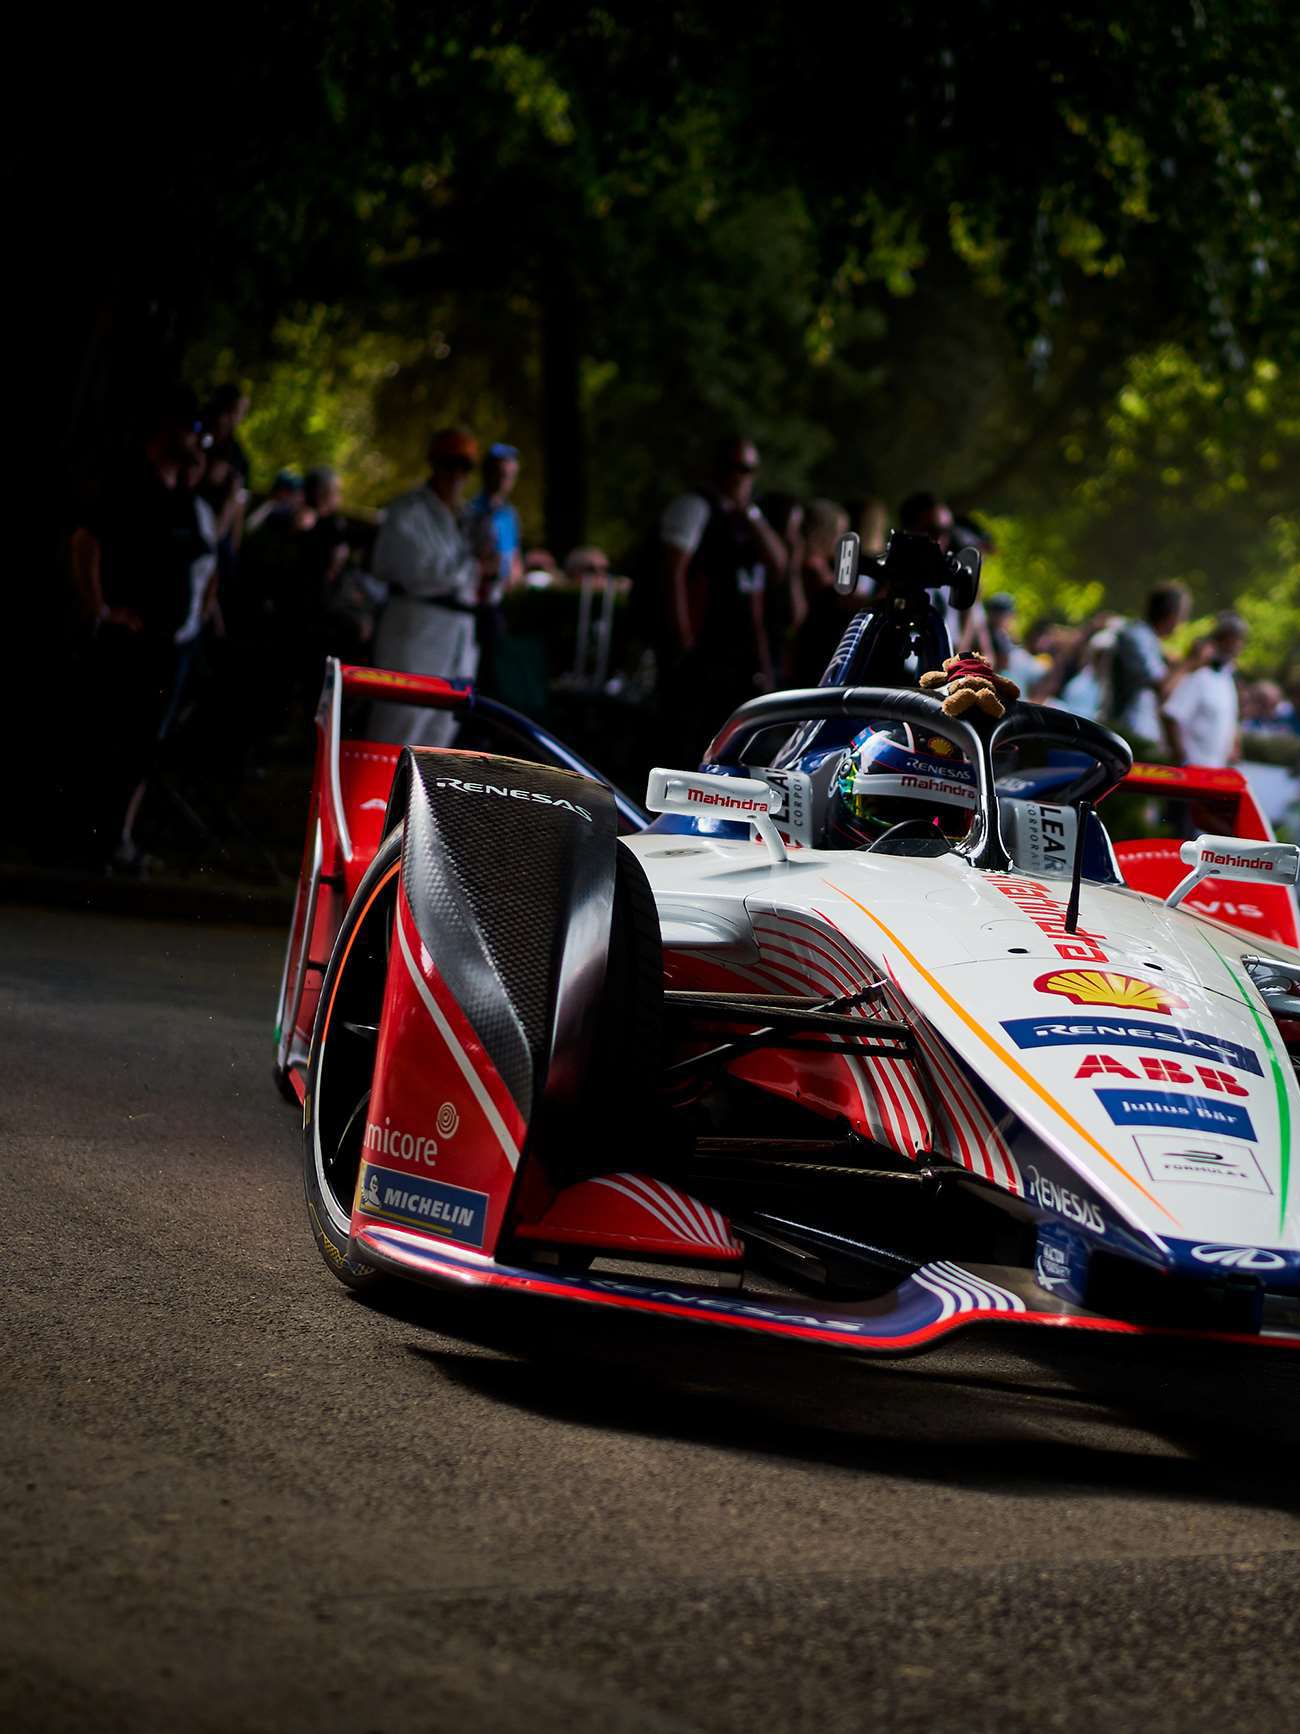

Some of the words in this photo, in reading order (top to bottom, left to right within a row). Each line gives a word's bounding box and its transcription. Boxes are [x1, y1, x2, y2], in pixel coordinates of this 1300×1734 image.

[906, 757, 972, 779] RENESAS
[435, 777, 593, 823] RENESAS
[687, 788, 768, 811] Mahindra
[901, 776, 976, 799] Mahindra
[1039, 806, 1066, 871] LEAR
[1200, 850, 1274, 870] Mahindra
[1033, 1024, 1238, 1062] RENESAS
[1074, 1054, 1250, 1097] ABB
[1122, 1101, 1189, 1116] Julius
[1197, 1103, 1238, 1123] Bär
[384, 1187, 475, 1227] MICHELIN
[1027, 1164, 1106, 1235] RENESAS
